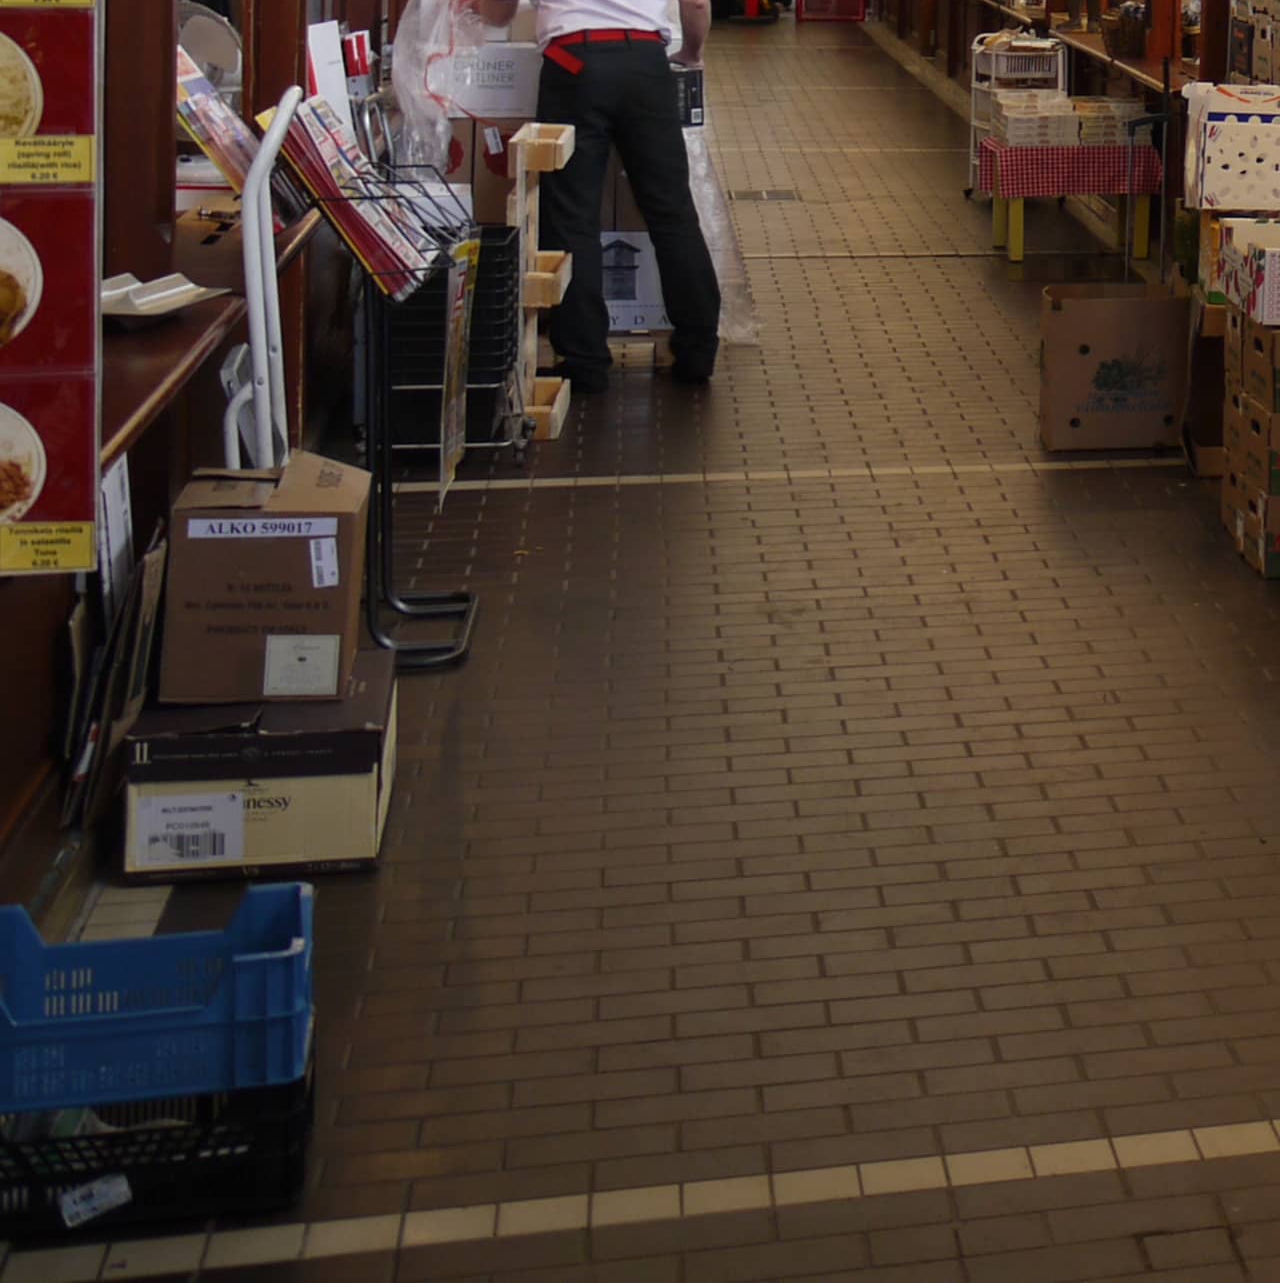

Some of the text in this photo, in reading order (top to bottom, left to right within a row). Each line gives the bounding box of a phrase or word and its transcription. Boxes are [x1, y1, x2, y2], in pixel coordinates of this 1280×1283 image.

[206, 521, 313, 535] ALKO 599017
[243, 796, 292, 813] nessy
